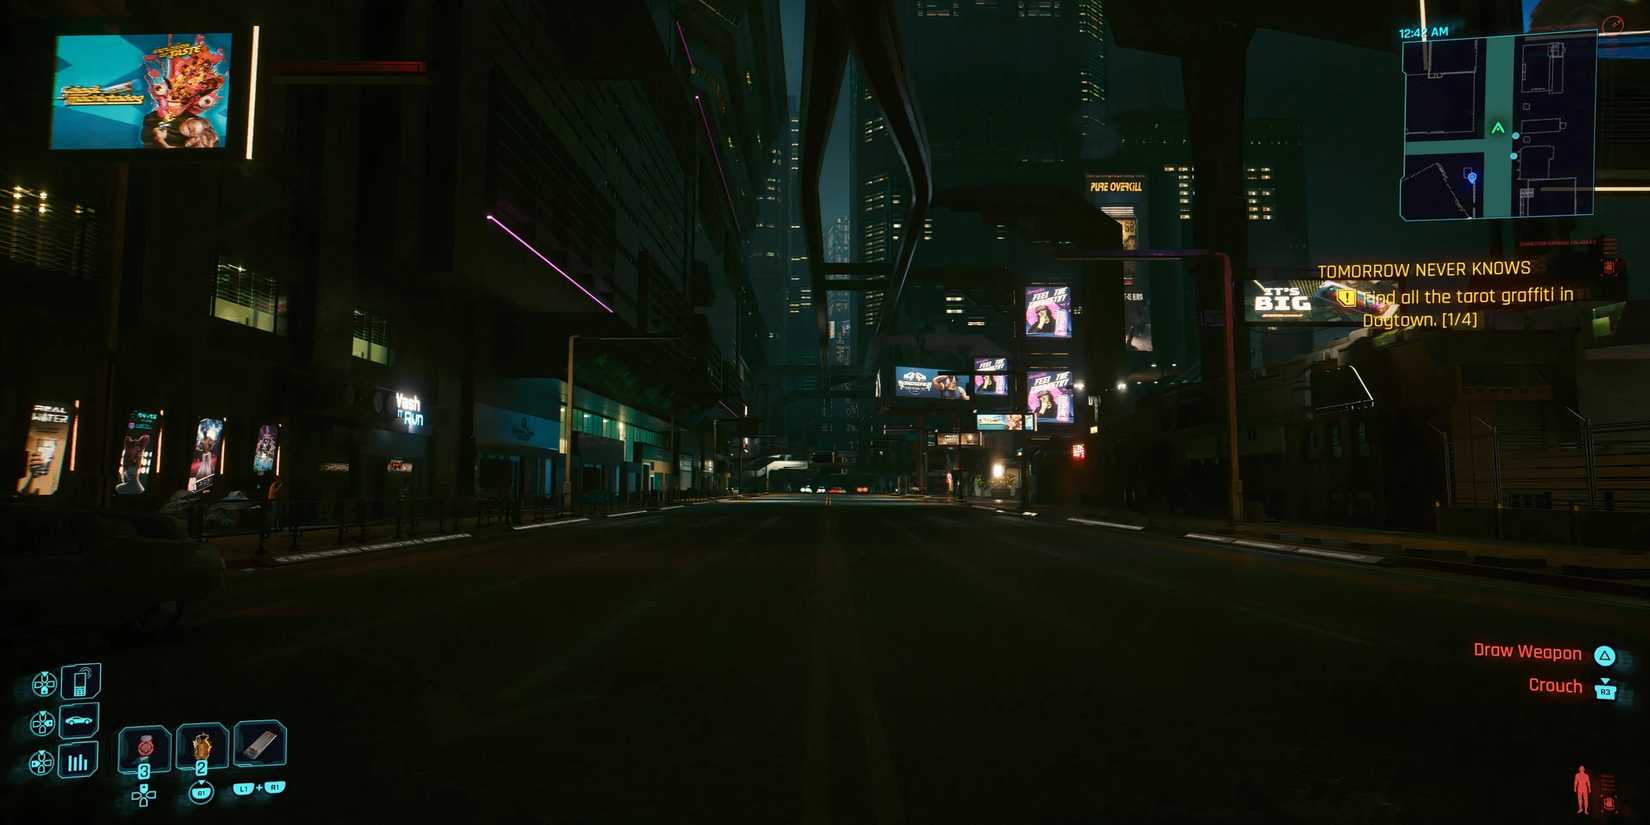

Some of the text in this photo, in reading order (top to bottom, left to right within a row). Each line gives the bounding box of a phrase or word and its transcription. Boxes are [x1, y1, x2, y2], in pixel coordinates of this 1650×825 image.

[1090, 181, 1143, 192] PURE OVERKILL
[1264, 287, 1300, 296] IT'S
[1254, 296, 1312, 311] BIG
